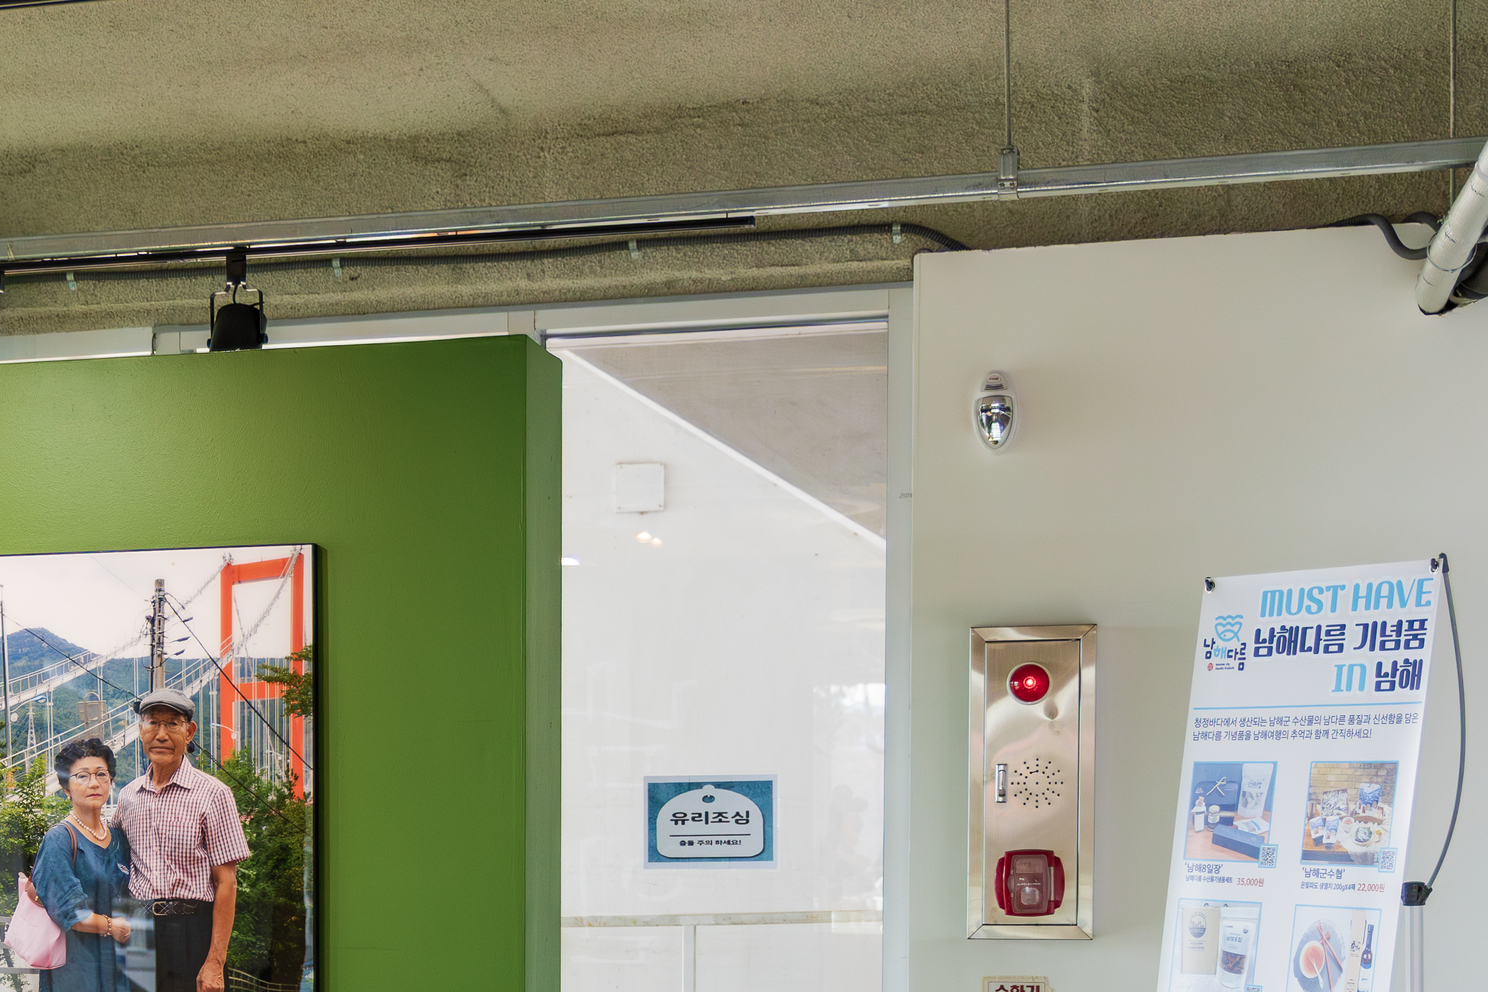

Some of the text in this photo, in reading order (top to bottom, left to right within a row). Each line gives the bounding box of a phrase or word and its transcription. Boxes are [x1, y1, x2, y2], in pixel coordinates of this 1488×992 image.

[1260, 577, 1434, 618] MUST HAVE
[1253, 618, 1429, 657] 남해다름 기념품
[1203, 637, 1247, 671] 남해다름
[1375, 658, 1423, 692] 남해
[1194, 712, 1419, 728] 청정바다에서 생산되는 남해군 수산물의 남다른 품질과 신선함을 담은
[1192, 728, 1372, 741] 남해다름 기념품을 남해여행의 추억과 함께 간직하세요!
[670, 810, 750, 826] 유리조심
[1236, 877, 1264, 887] 35,000원
[1357, 883, 1385, 893] 22,000원
